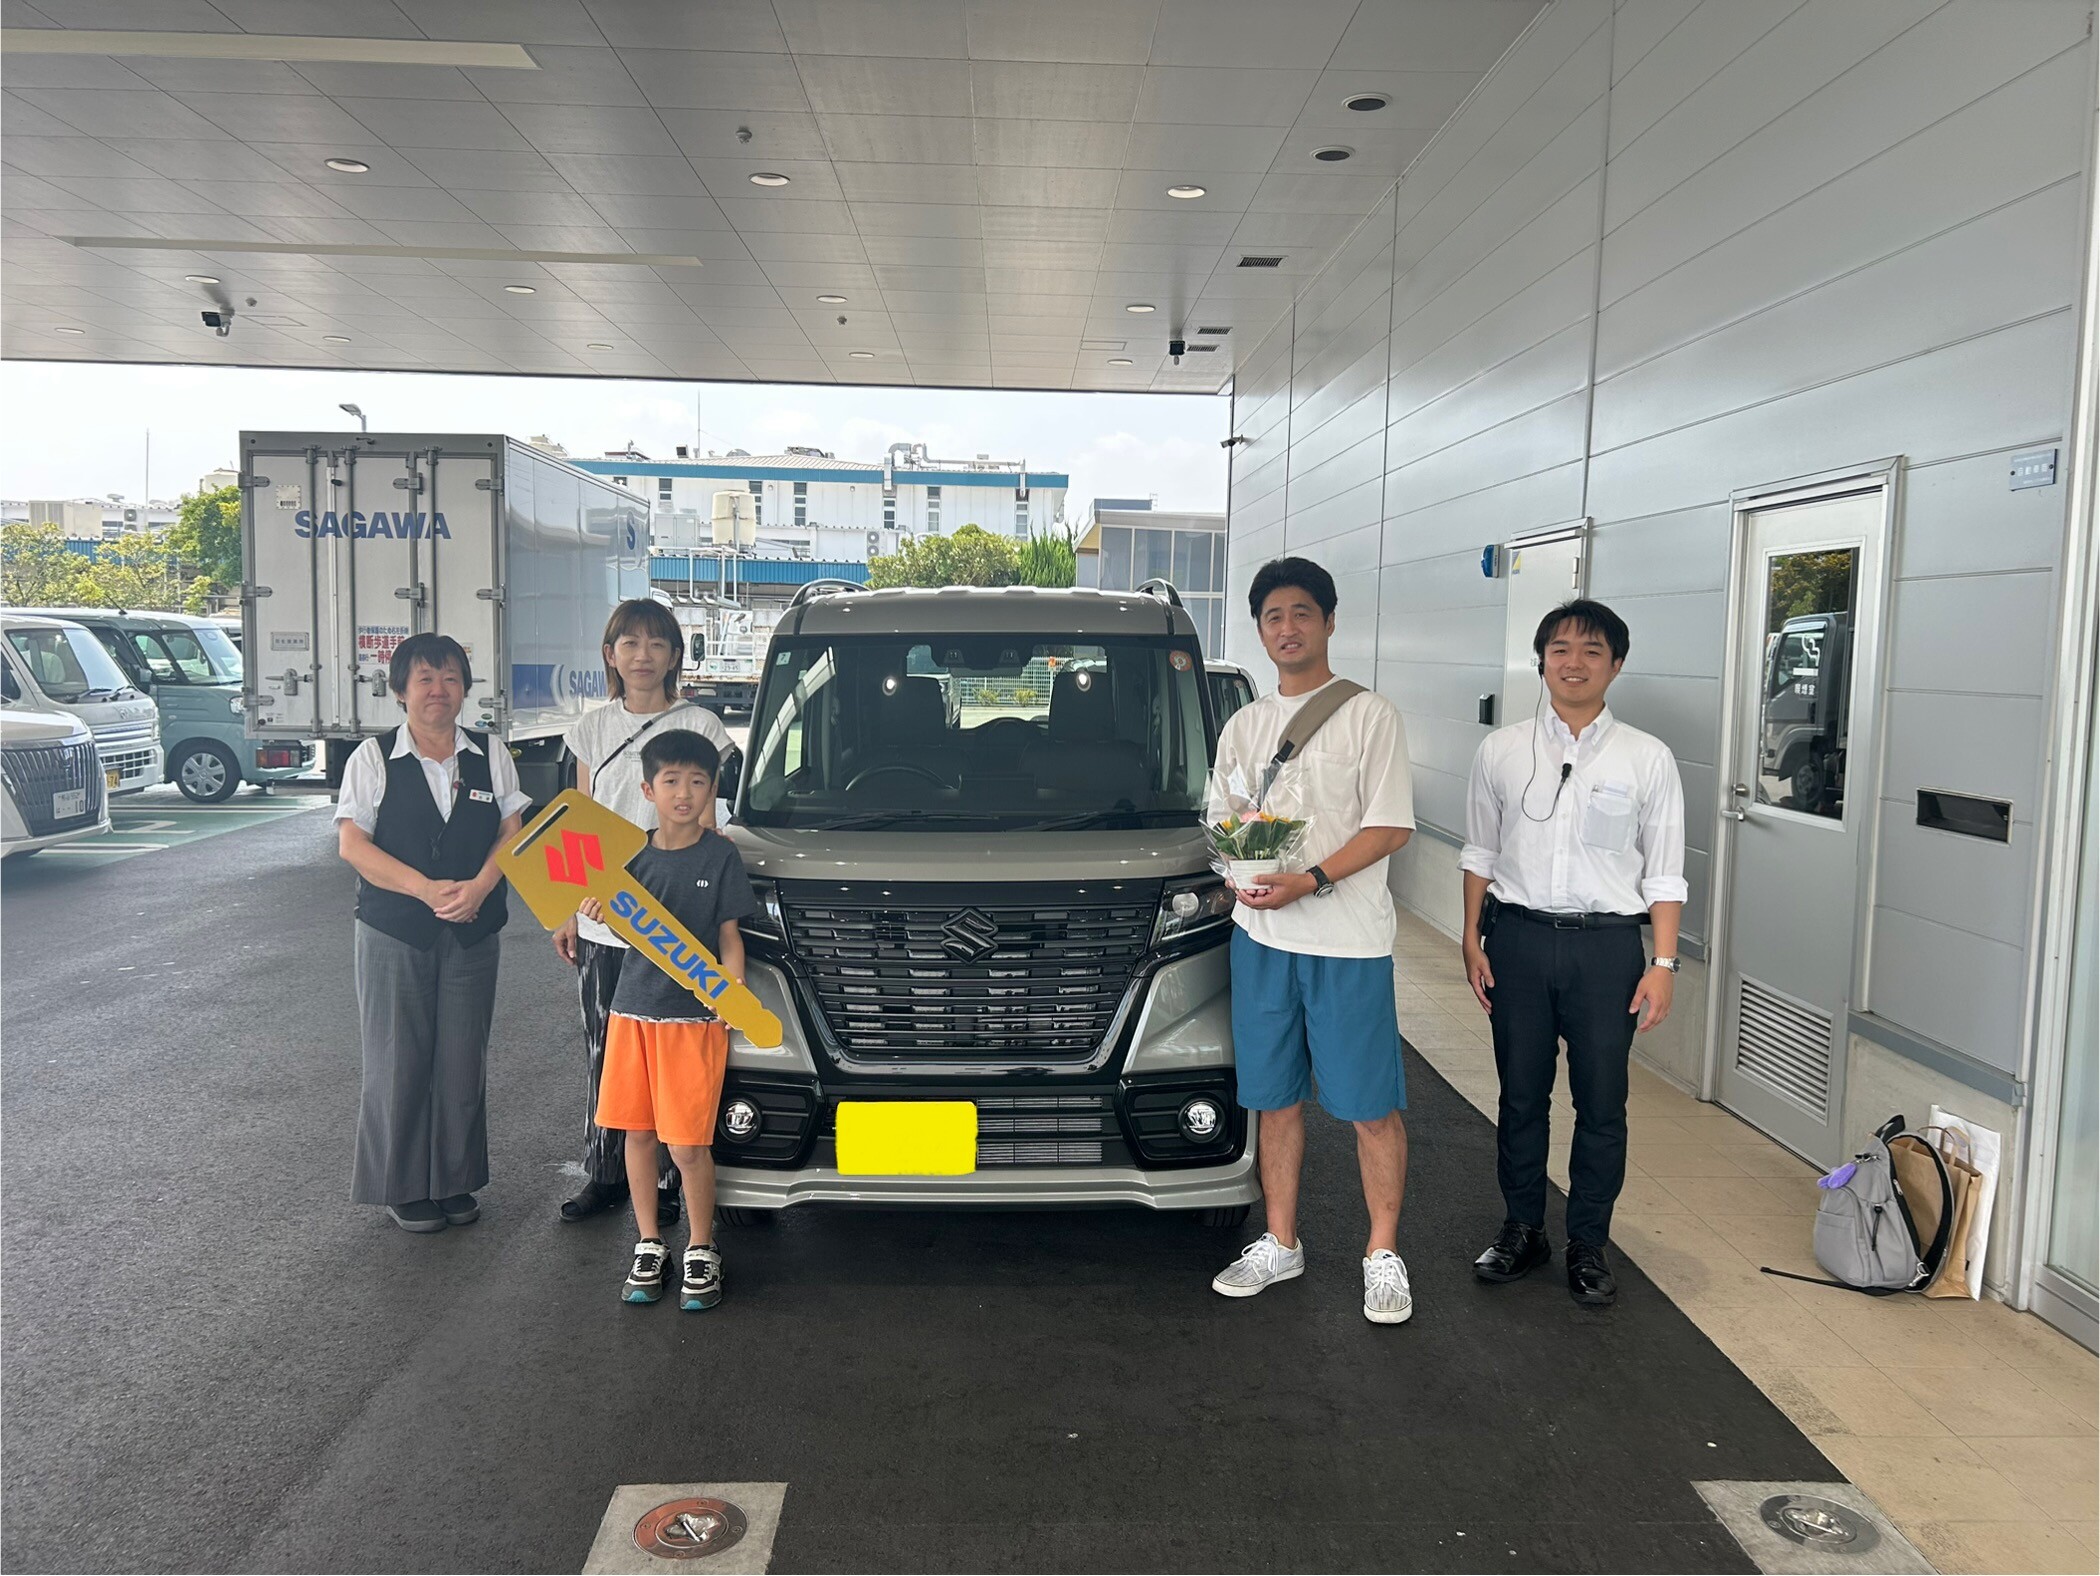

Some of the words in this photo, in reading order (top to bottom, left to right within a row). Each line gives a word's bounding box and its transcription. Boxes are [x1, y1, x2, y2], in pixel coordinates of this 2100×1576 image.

[294, 510, 452, 540] SAGAWA
[370, 650, 393, 664] 一時停
[569, 670, 608, 698] SAGAW
[609, 890, 729, 999] SUZUKI
